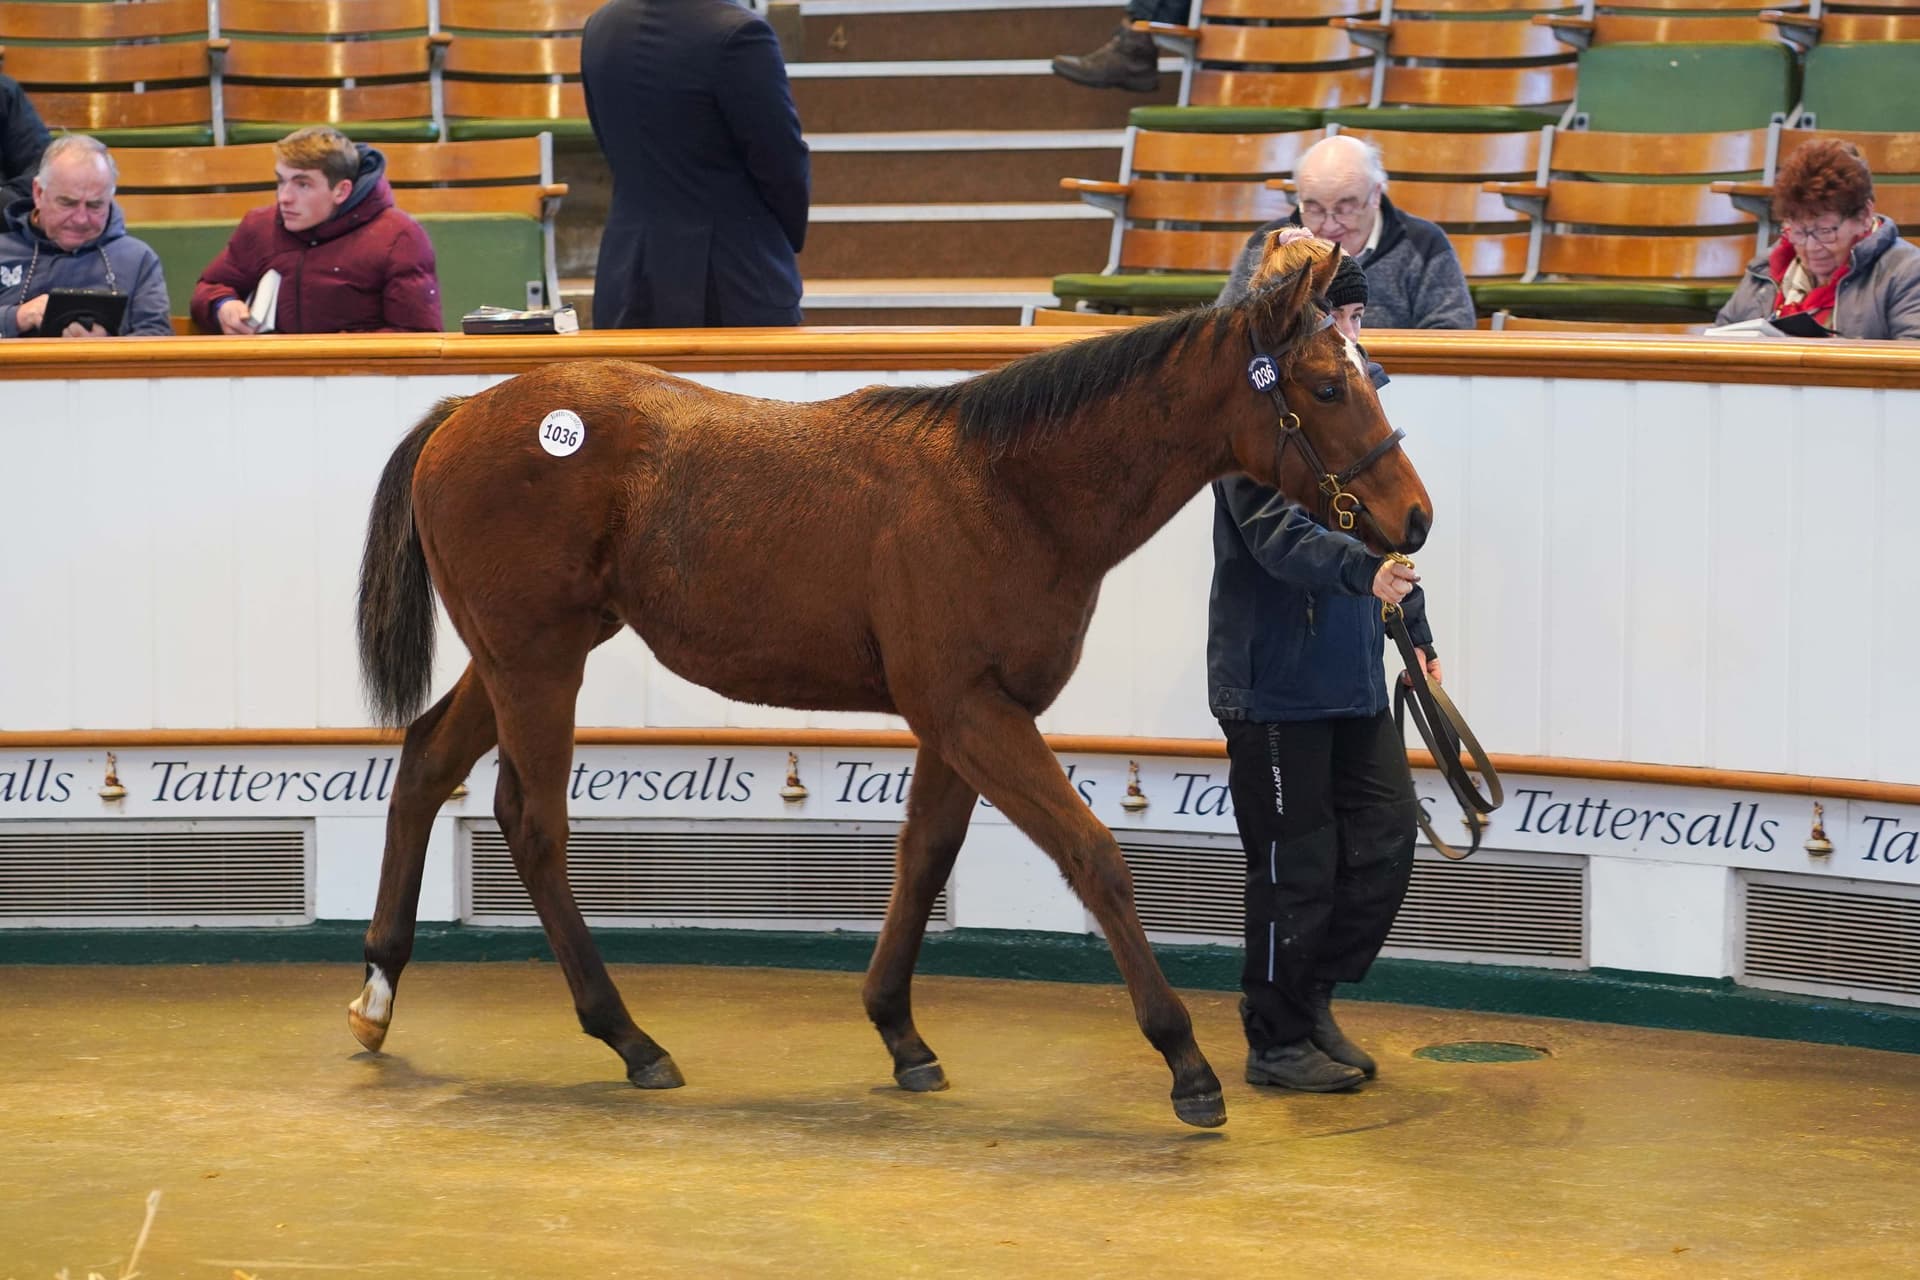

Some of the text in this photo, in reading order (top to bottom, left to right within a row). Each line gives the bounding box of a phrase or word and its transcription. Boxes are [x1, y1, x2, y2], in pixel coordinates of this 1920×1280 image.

[830, 25, 848, 49] 4
[1252, 363, 1276, 389] 1036
[544, 424, 578, 447] 1036
[151, 757, 394, 802] Tattersall
[571, 756, 755, 802] tersalls
[1515, 789, 1780, 853] Tattersalls
